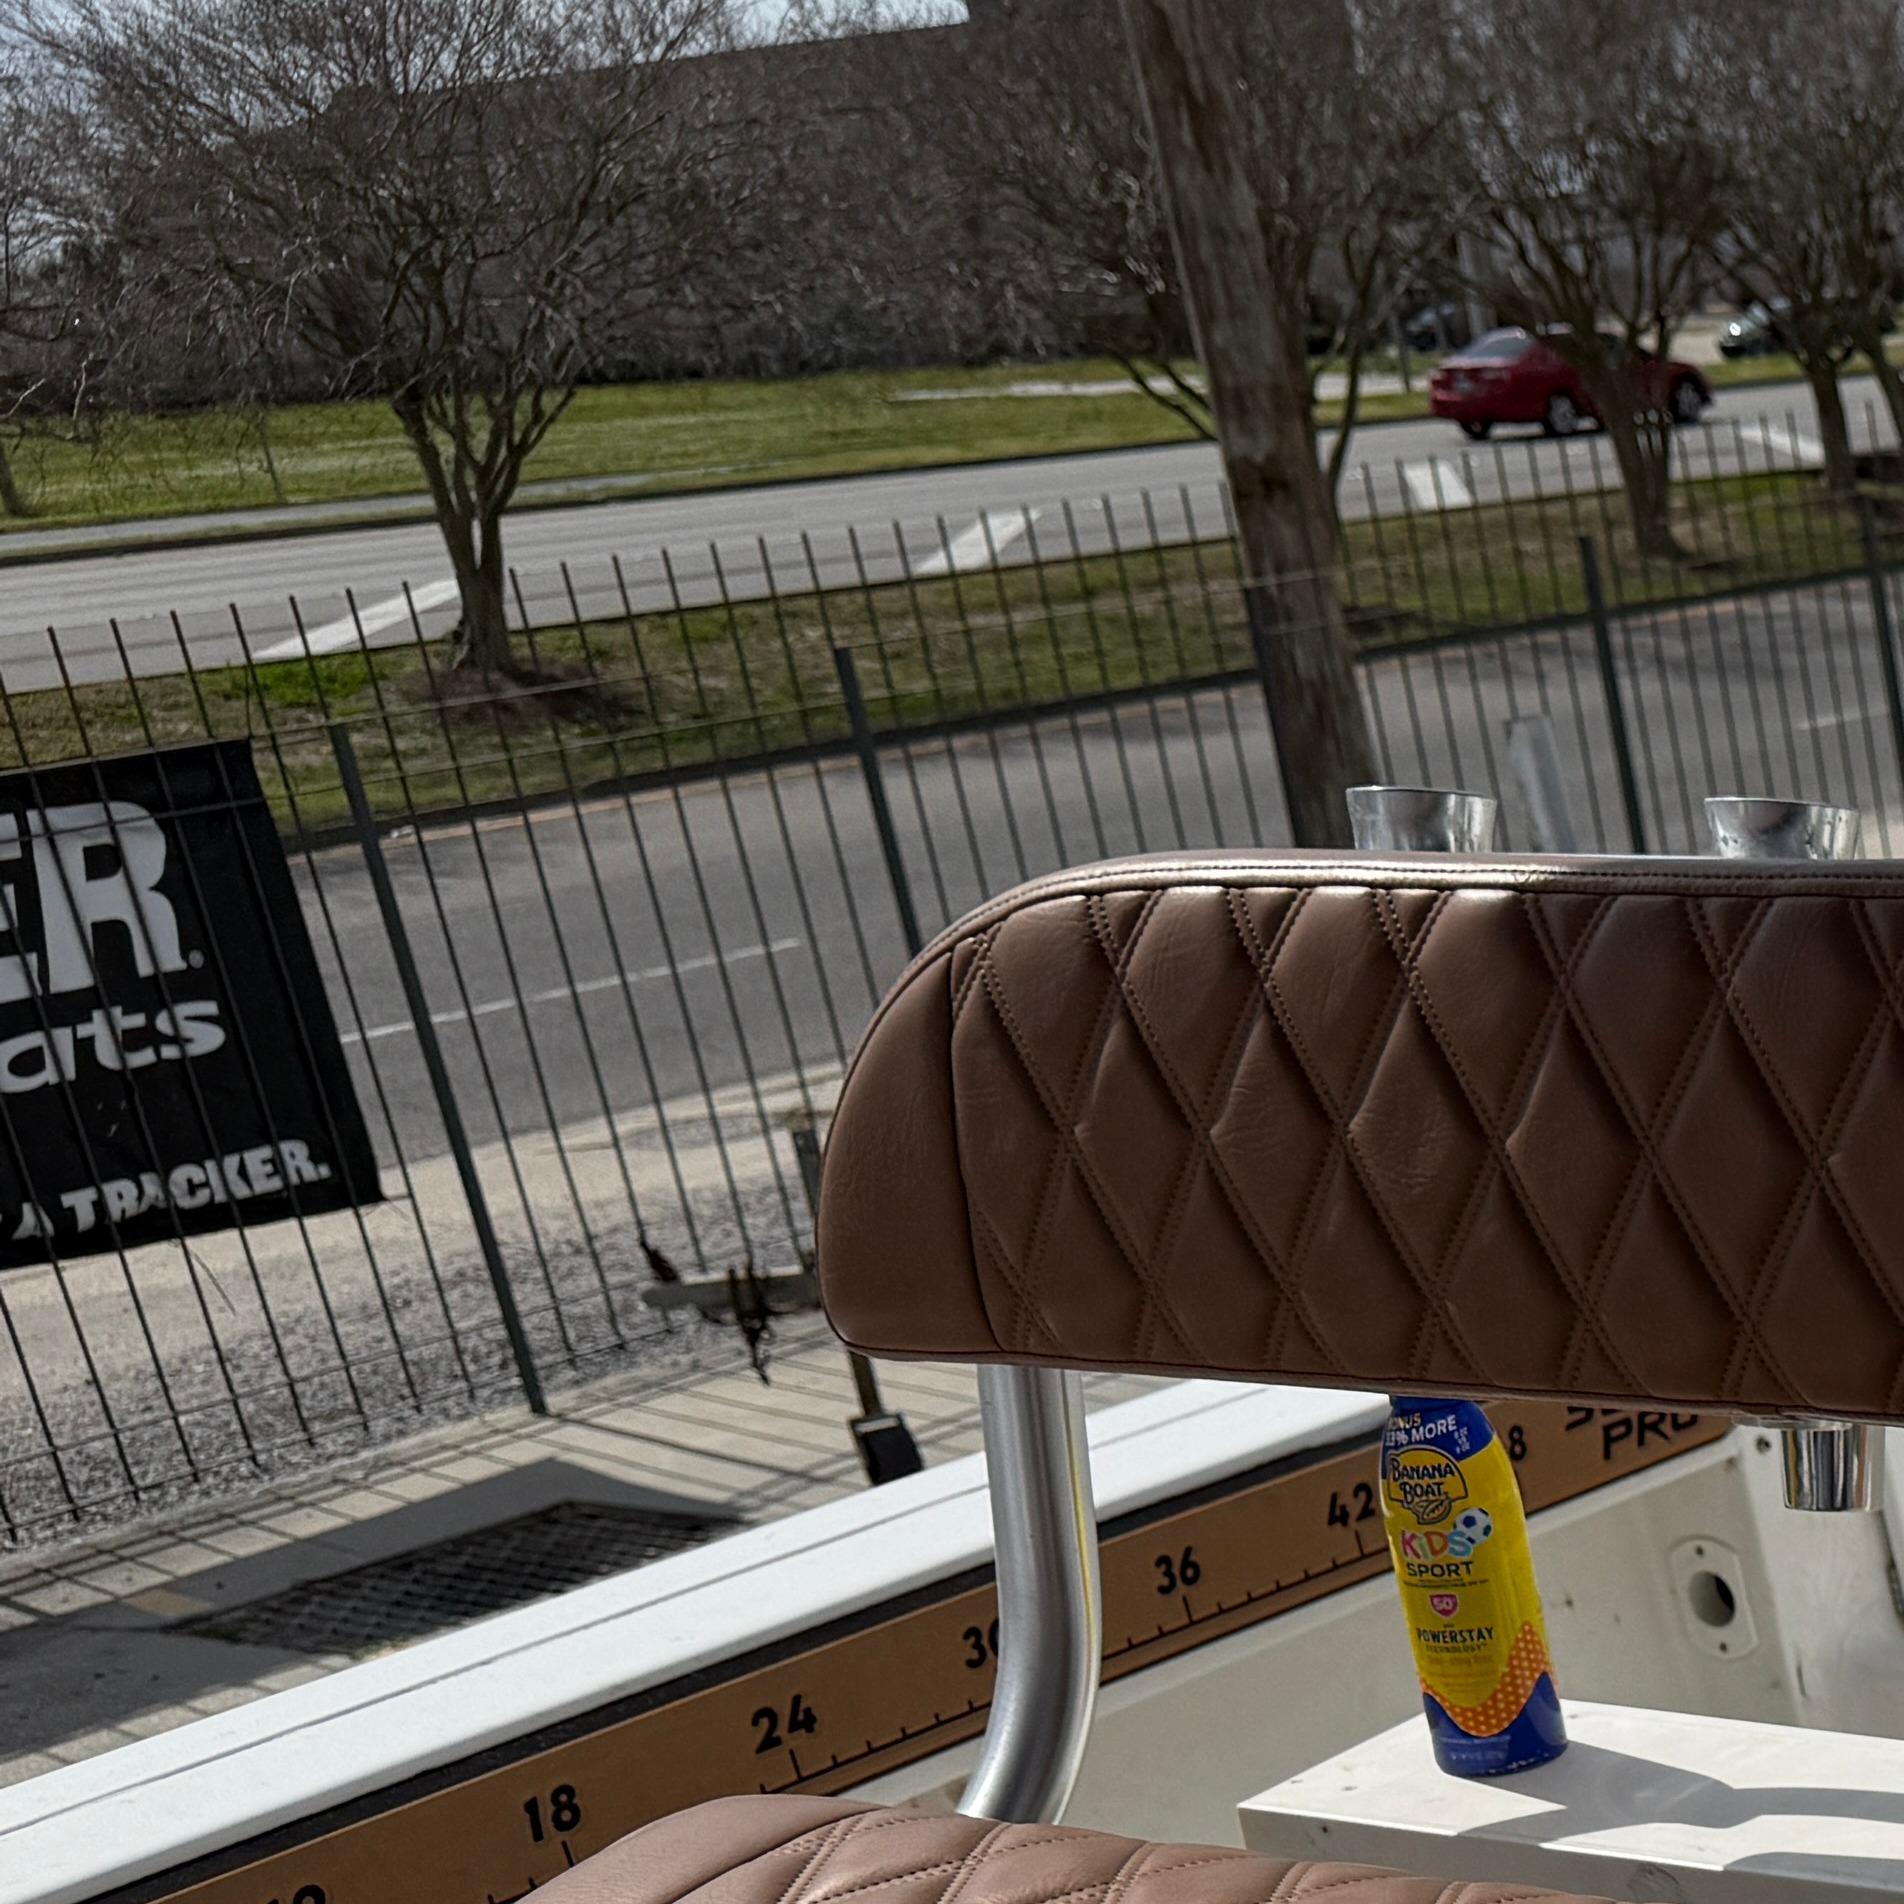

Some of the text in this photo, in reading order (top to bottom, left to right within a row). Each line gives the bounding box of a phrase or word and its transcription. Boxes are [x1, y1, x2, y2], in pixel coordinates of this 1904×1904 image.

[1411, 1414, 1457, 1443] MORE
[1390, 1457, 1455, 1482] BANANA
[1327, 1482, 1376, 1528] 42
[1399, 1482, 1445, 1505] BOAT
[1154, 1546, 1202, 1596] 36
[1406, 1561, 1475, 1578] SPORT
[751, 1694, 817, 1754] 24
[523, 1784, 582, 1842] 18
